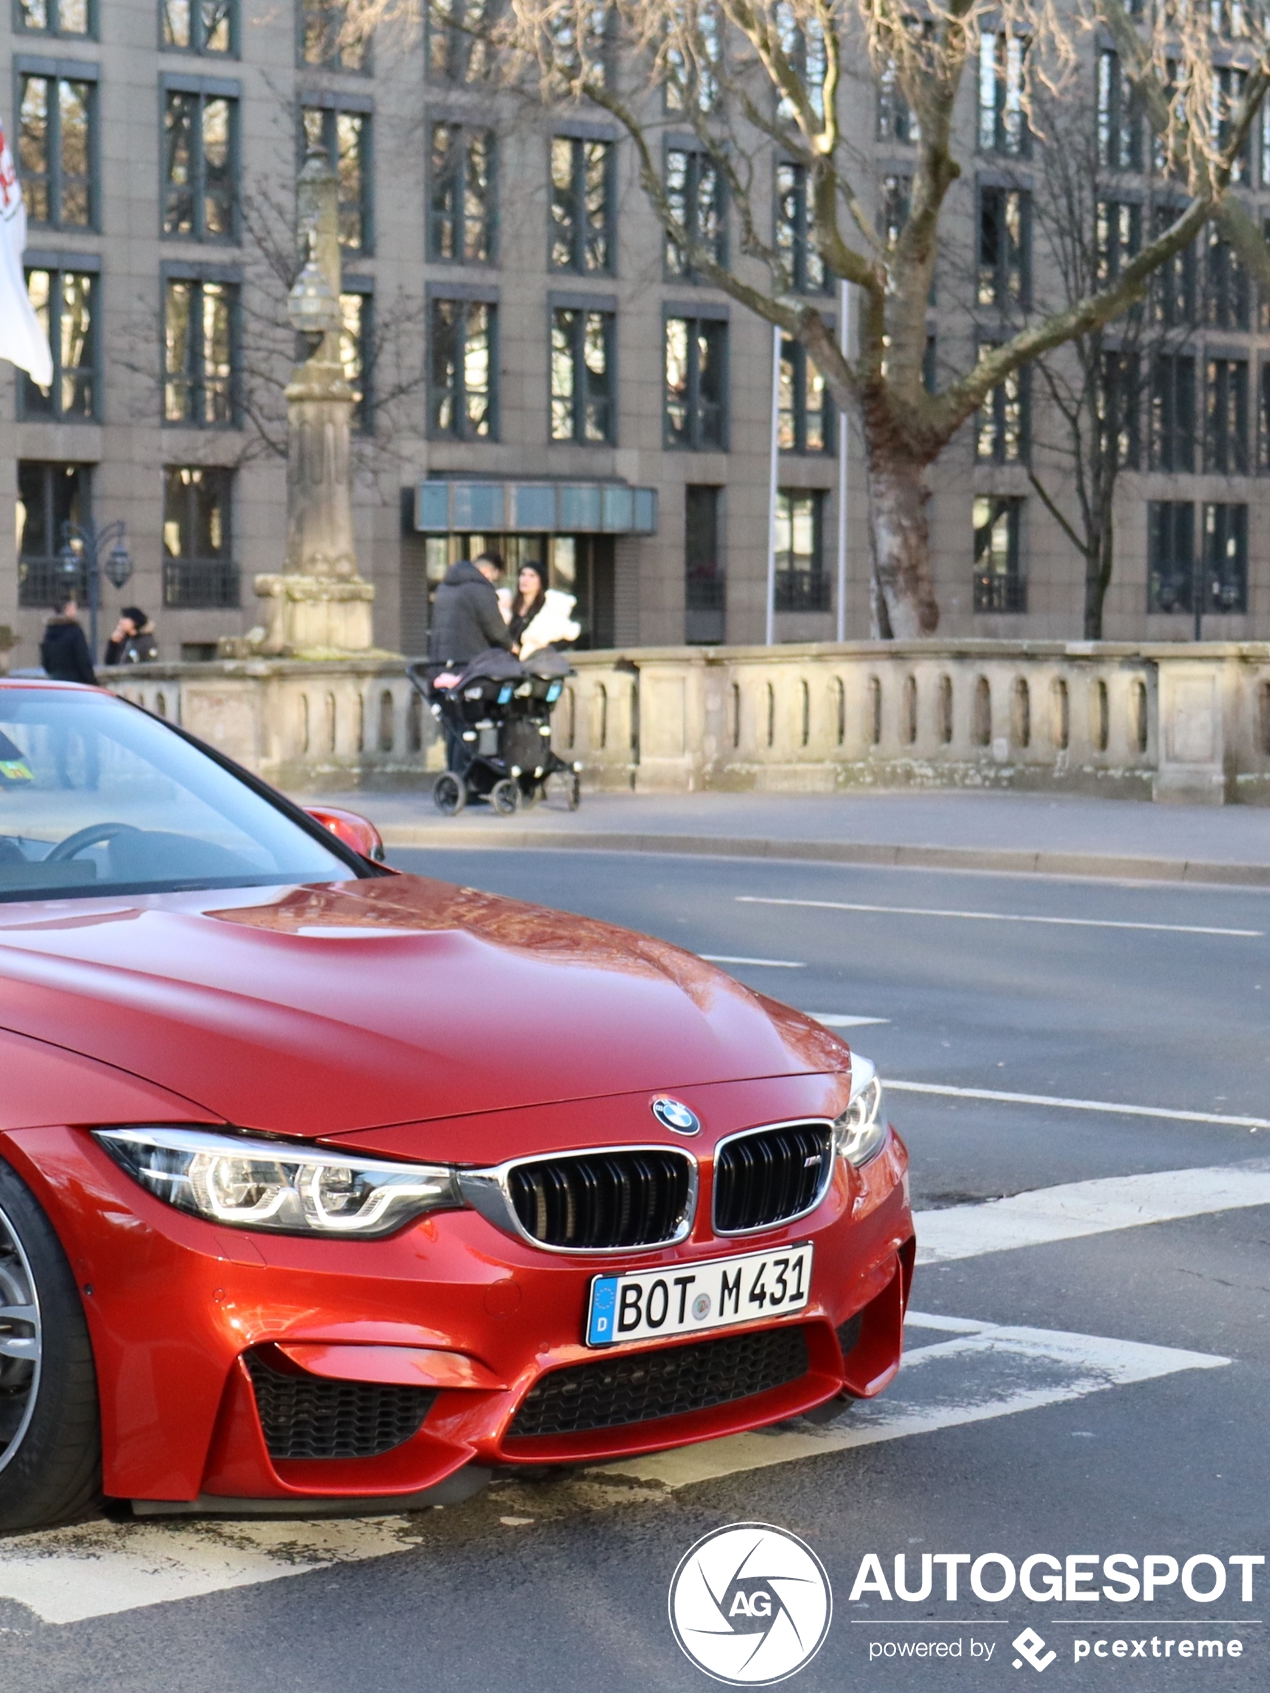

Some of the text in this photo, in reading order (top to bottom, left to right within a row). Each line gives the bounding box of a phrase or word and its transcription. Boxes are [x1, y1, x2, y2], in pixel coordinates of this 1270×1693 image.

[617, 1254, 805, 1333] BOT M 431
[596, 1317, 608, 1332] D
